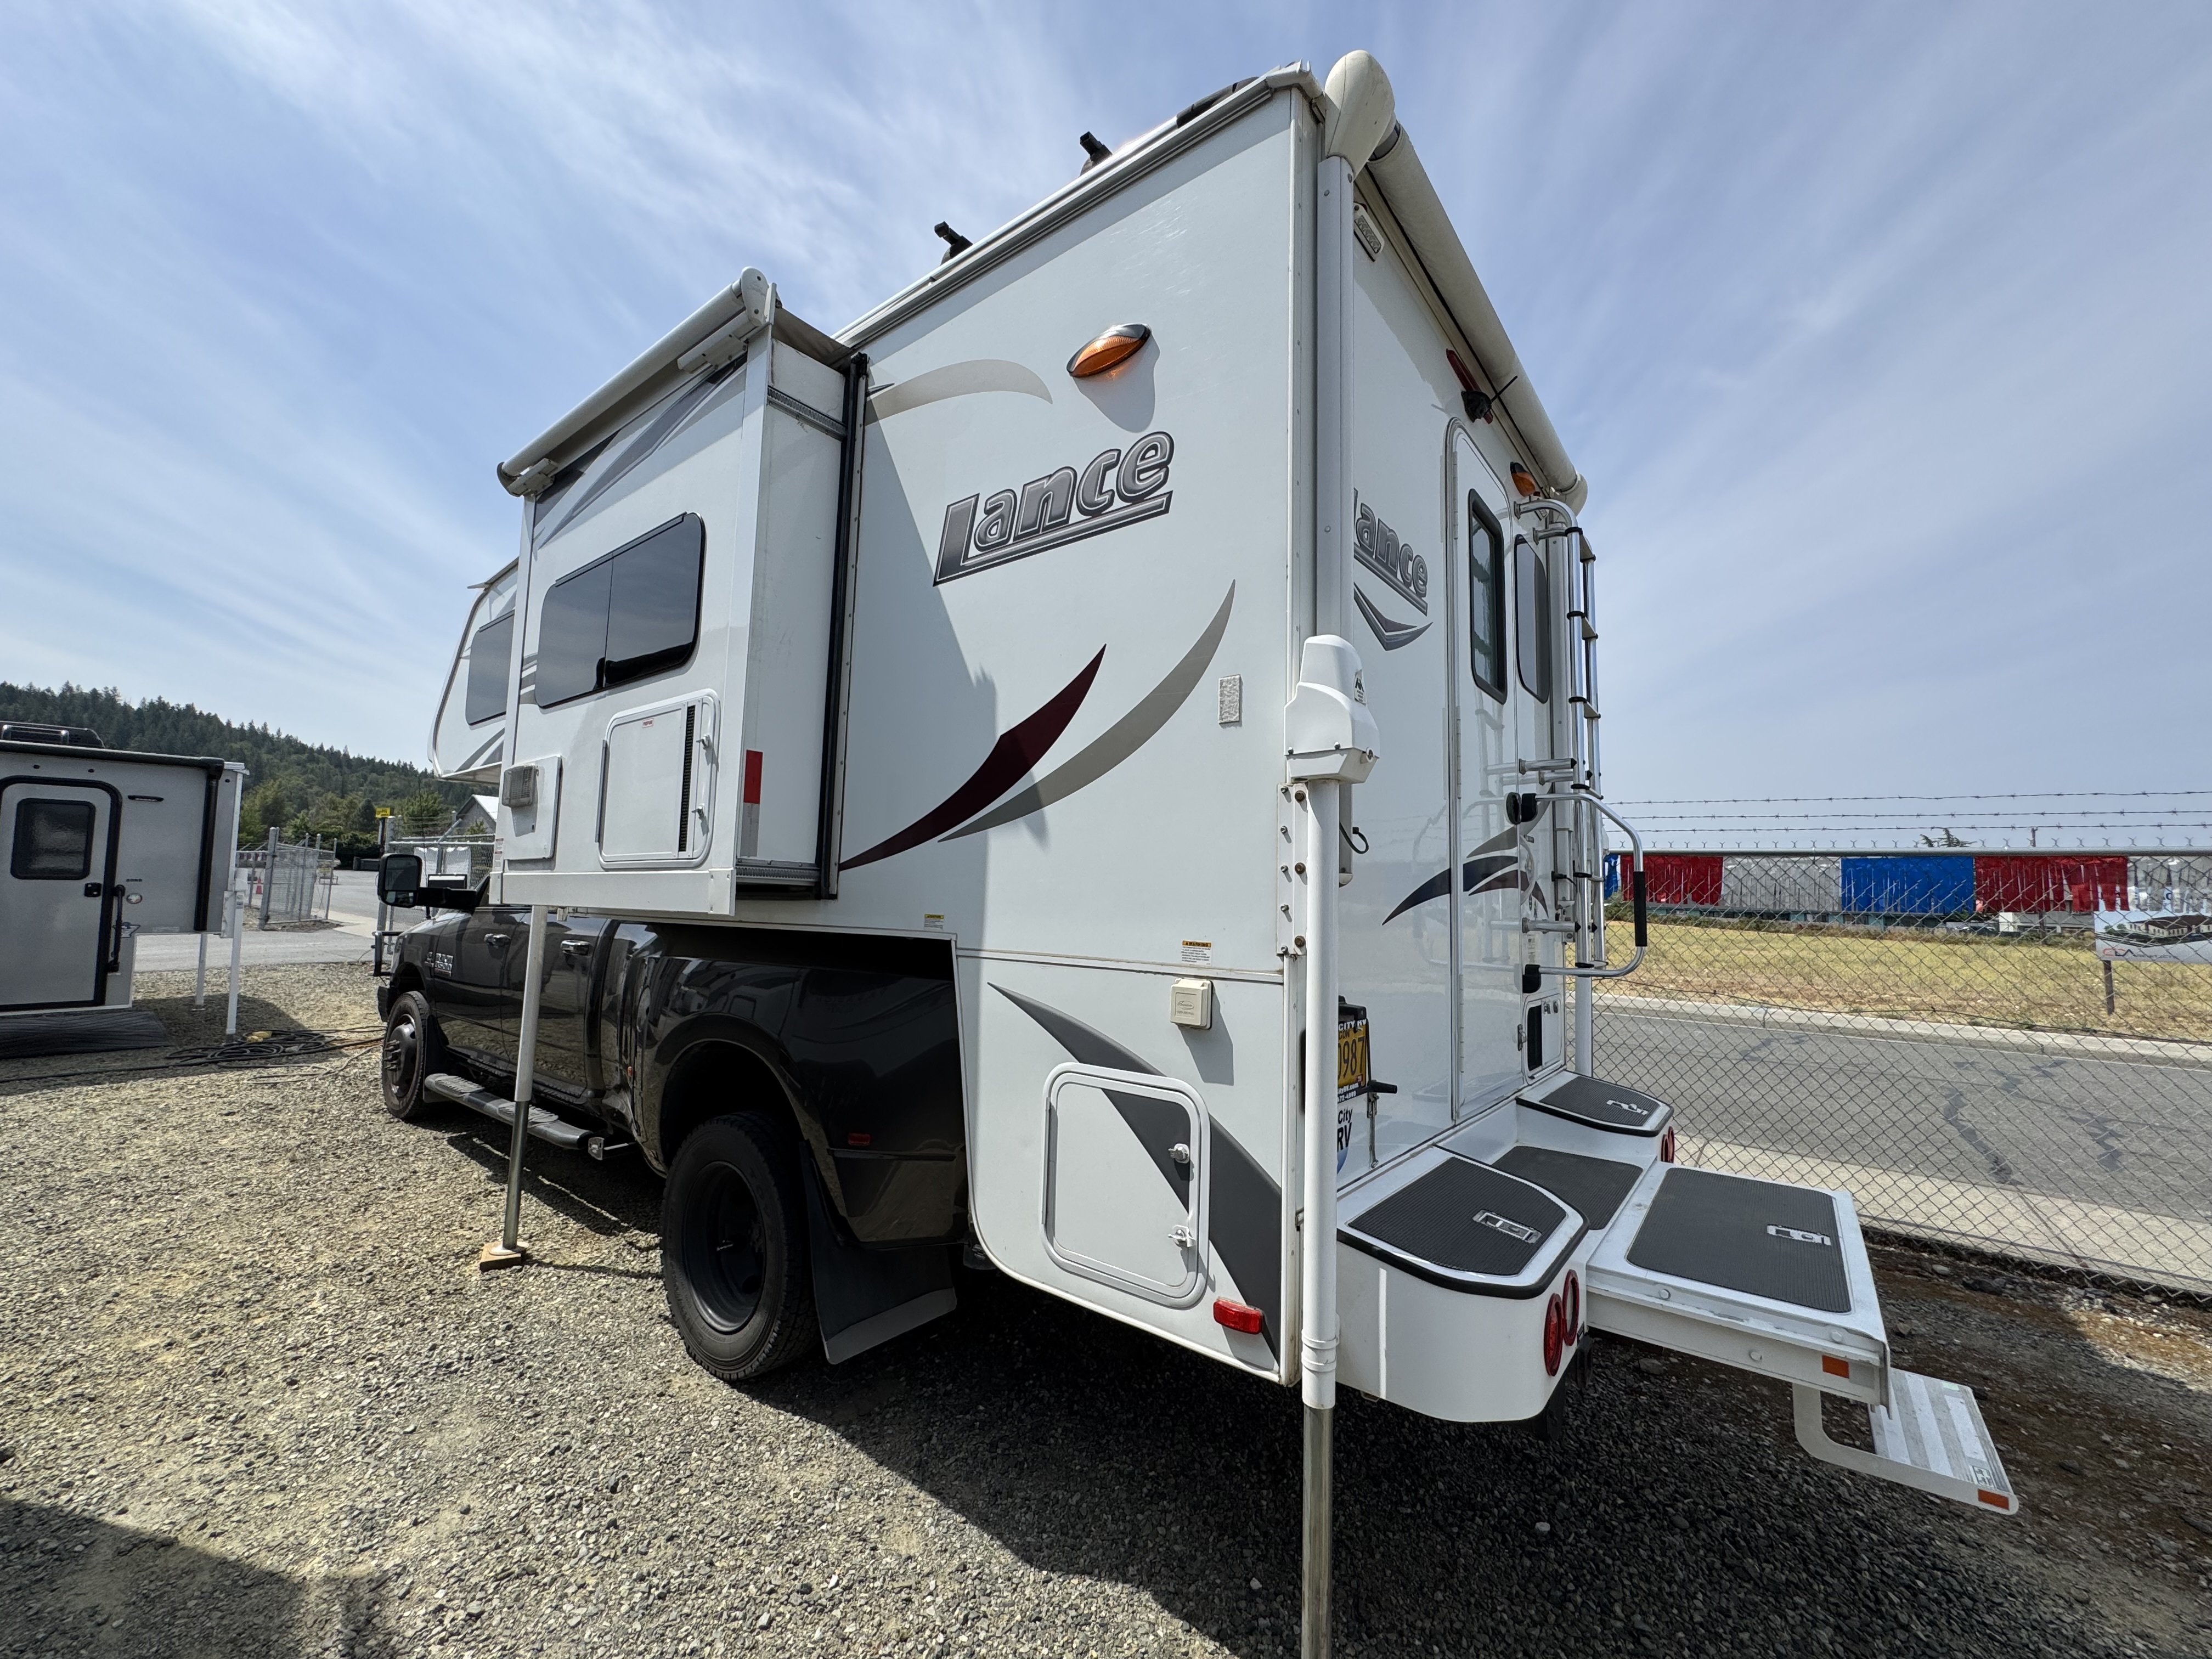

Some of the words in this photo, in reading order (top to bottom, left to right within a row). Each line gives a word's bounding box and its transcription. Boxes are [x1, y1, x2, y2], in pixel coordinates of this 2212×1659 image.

[933, 431, 1175, 588] Lance
[1353, 487, 1428, 617] ance
[1339, 1020, 1356, 1031] CITY
[1338, 1107, 1353, 1124] City
[1338, 1122, 1352, 1153] RV
